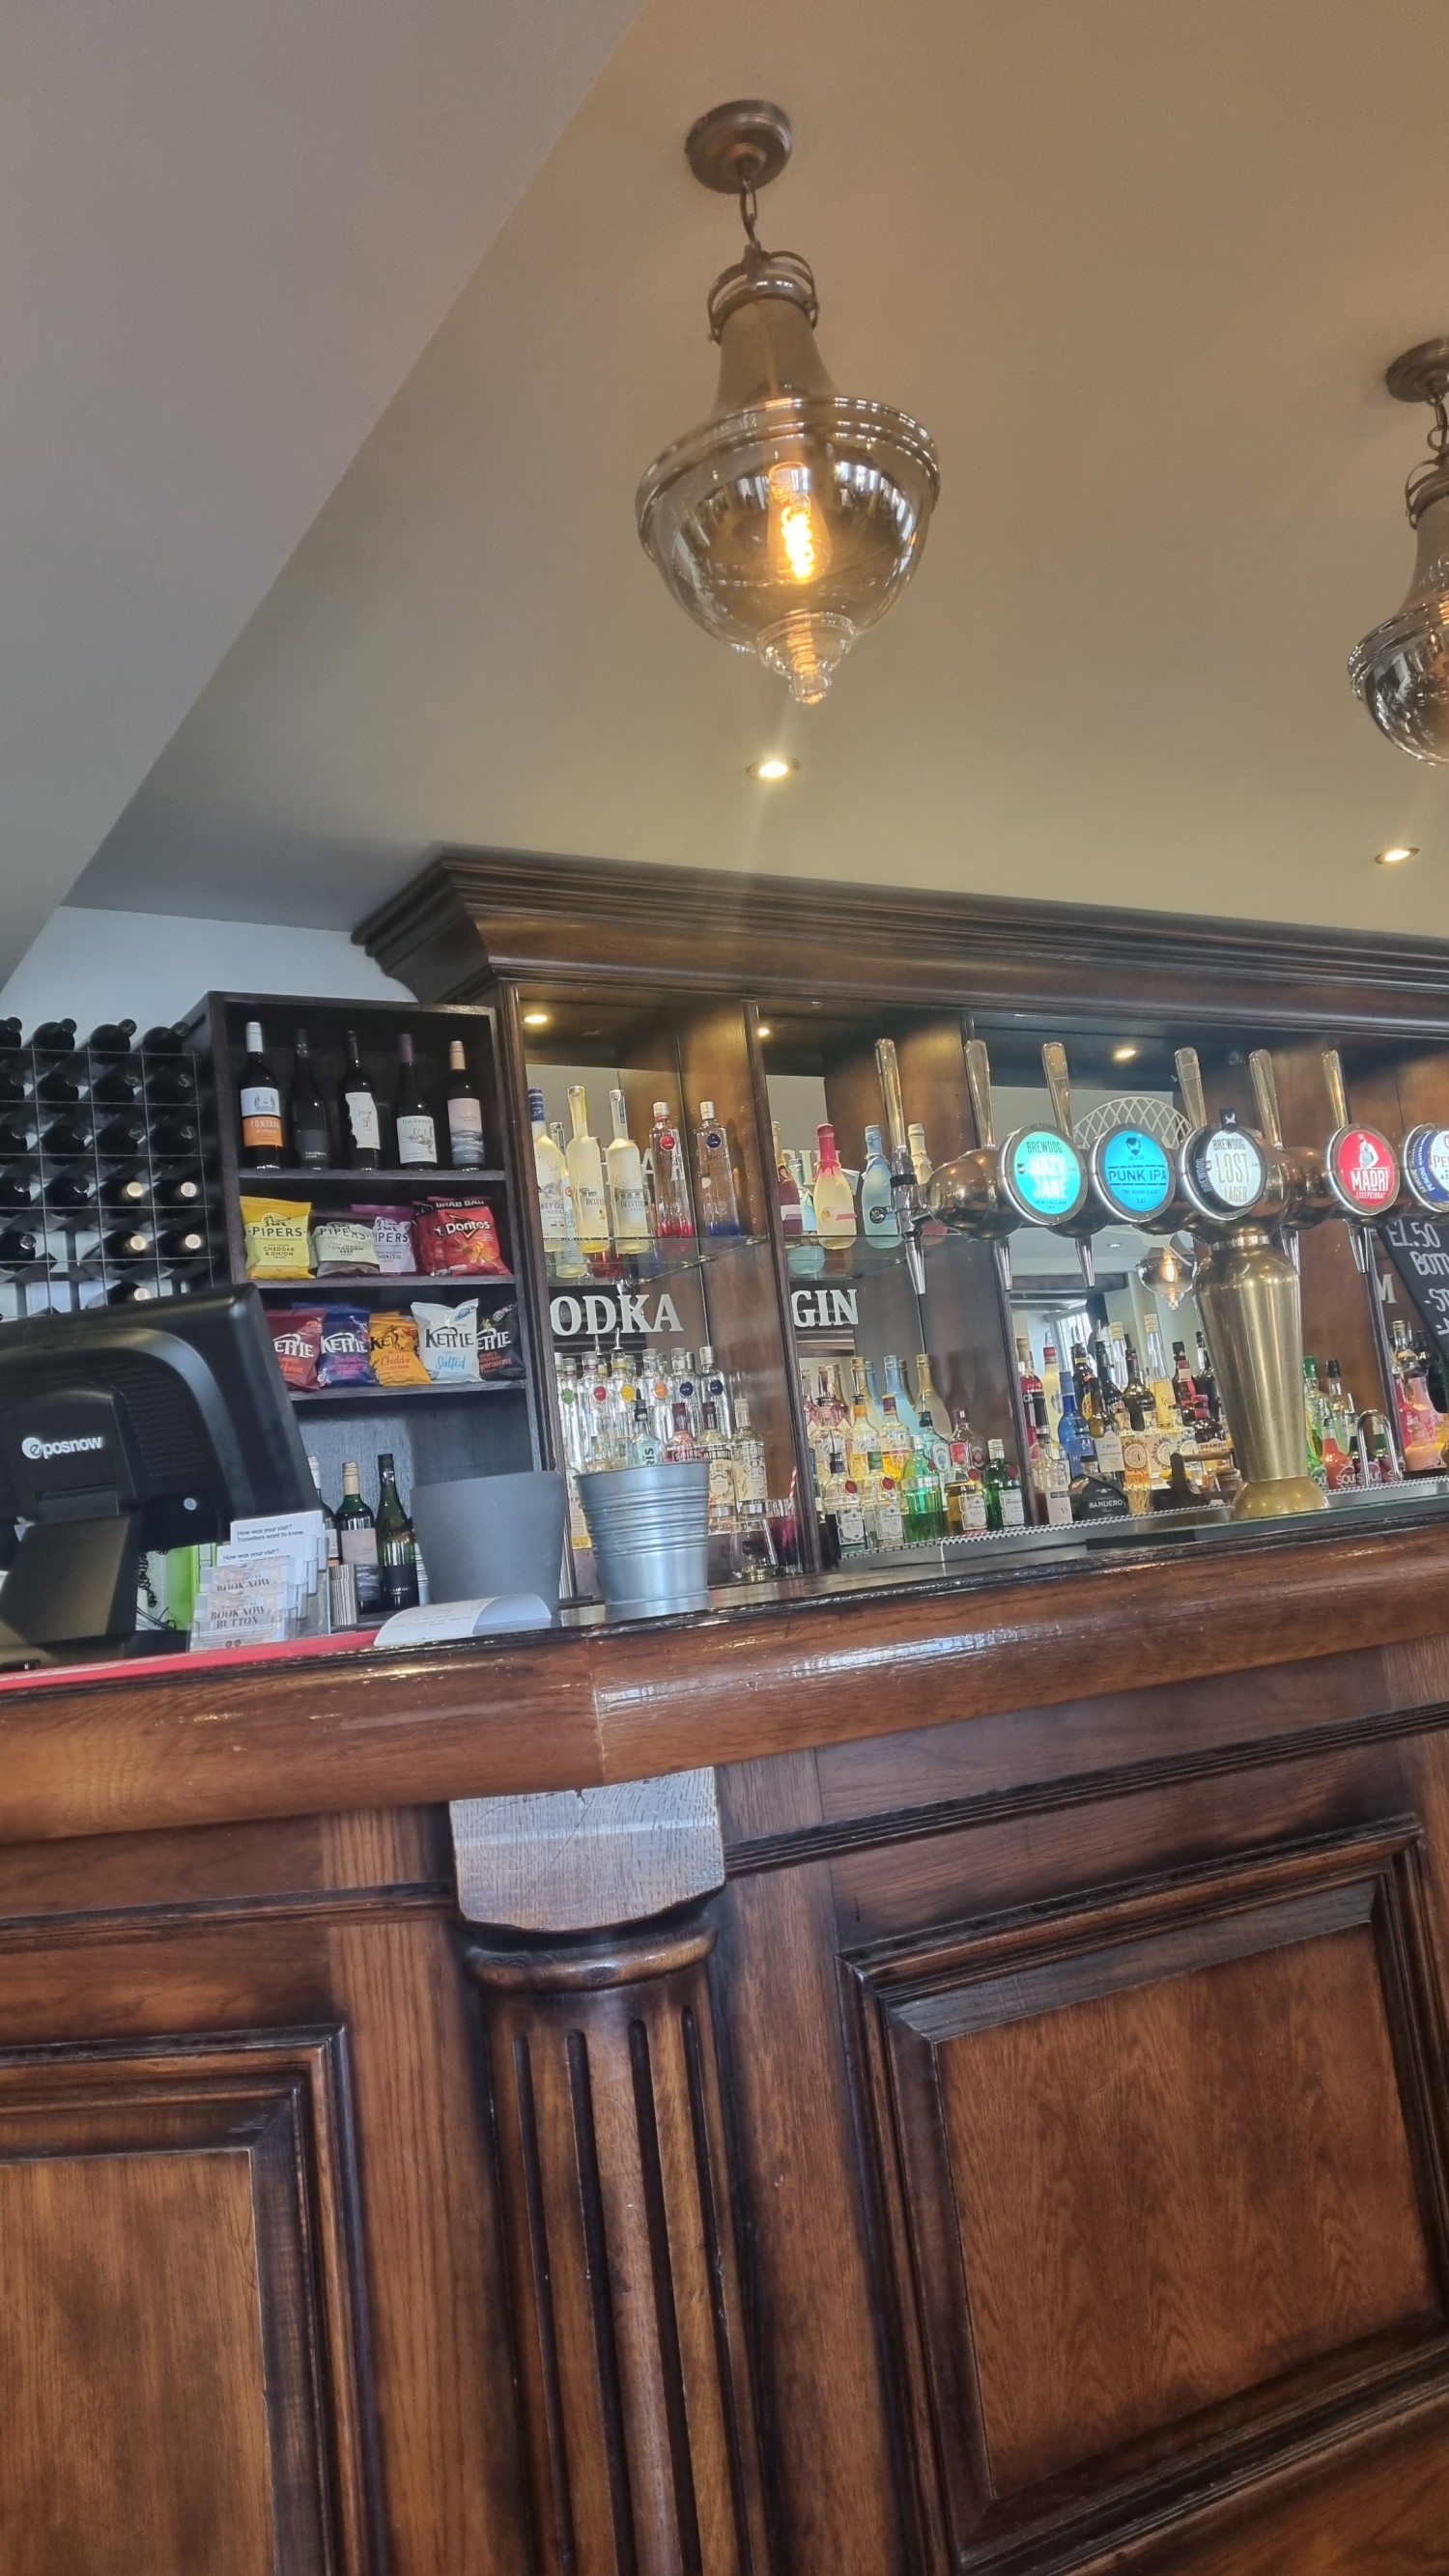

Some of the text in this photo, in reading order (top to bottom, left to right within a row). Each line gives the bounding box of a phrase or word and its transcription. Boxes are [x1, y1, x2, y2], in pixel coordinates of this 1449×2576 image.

[1026, 1142, 1063, 1153] BREWDOG
[1213, 1139, 1246, 1150] BREWDOG
[1030, 1155, 1065, 1175] HAZY
[1215, 1153, 1250, 1183] LOST
[1434, 1155, 1449, 1168] PE
[1109, 1170, 1167, 1181] PUNK IPA
[1196, 1158, 1212, 1193] BREWDOG
[1034, 1177, 1066, 1198] JANE
[1225, 1186, 1247, 1202] LAGER
[252, 1226, 302, 1236] PIPERS
[320, 1228, 365, 1240] PIPERS
[445, 1221, 491, 1234] Doritos
[375, 1231, 408, 1242] IPERS
[550, 1294, 684, 1336] ODKA
[791, 1289, 859, 1327] GIN
[321, 1333, 369, 1354] KETTLE
[426, 1326, 473, 1347] KETTLE
[477, 1327, 511, 1350] ETTLE
[272, 1334, 315, 1358] ETTLE
[436, 1354, 466, 1370] Salted
[22, 1436, 102, 1458] eposnow
[1089, 1500, 1123, 1509] BANDERO
[211, 1610, 240, 1620] BOOK
[243, 1605, 264, 1615] NOW
[217, 1616, 258, 1628] BUTTON
